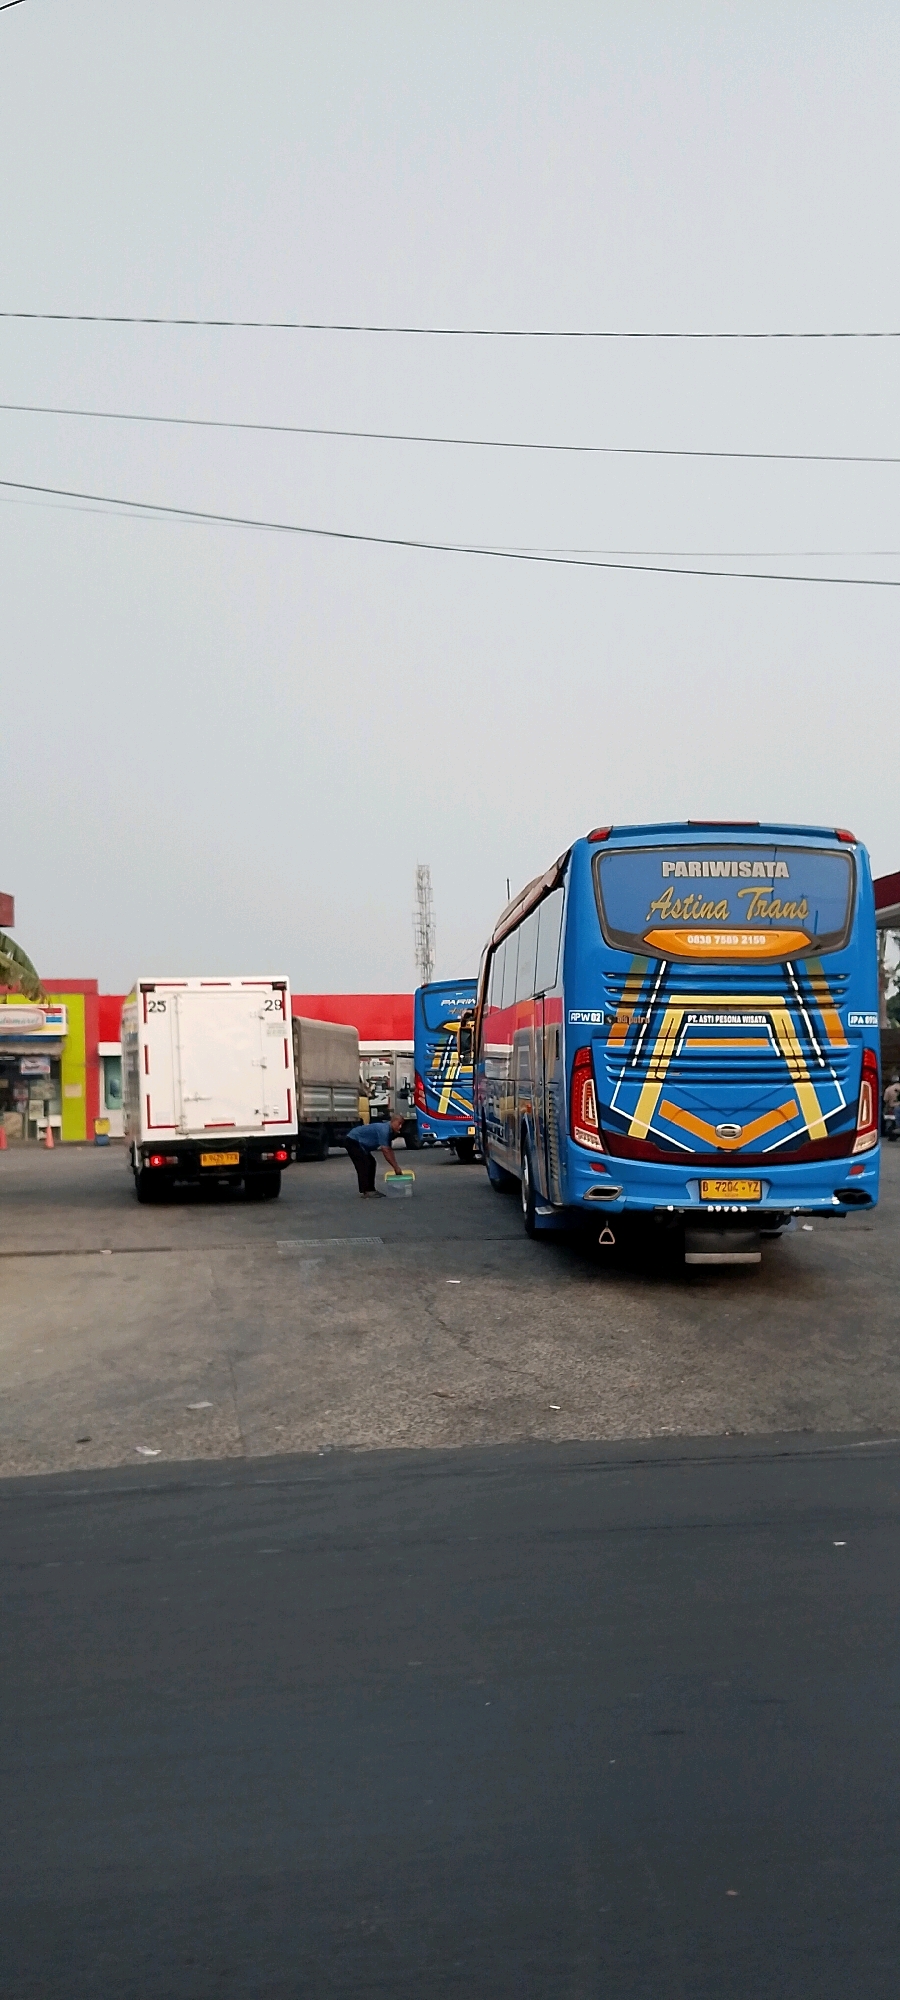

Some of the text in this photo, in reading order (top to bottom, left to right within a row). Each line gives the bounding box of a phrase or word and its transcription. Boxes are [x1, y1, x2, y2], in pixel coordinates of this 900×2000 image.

[662, 861, 790, 878] PARIWISATA
[645, 886, 809, 921] Astina Trans
[148, 1001, 167, 1013] 25
[699, 1015, 714, 1023] ASTI
[715, 1015, 741, 1024] PESONA
[742, 1015, 767, 1024] WISATA
[702, 1181, 709, 1192] B
[747, 1181, 760, 1192] YZ
